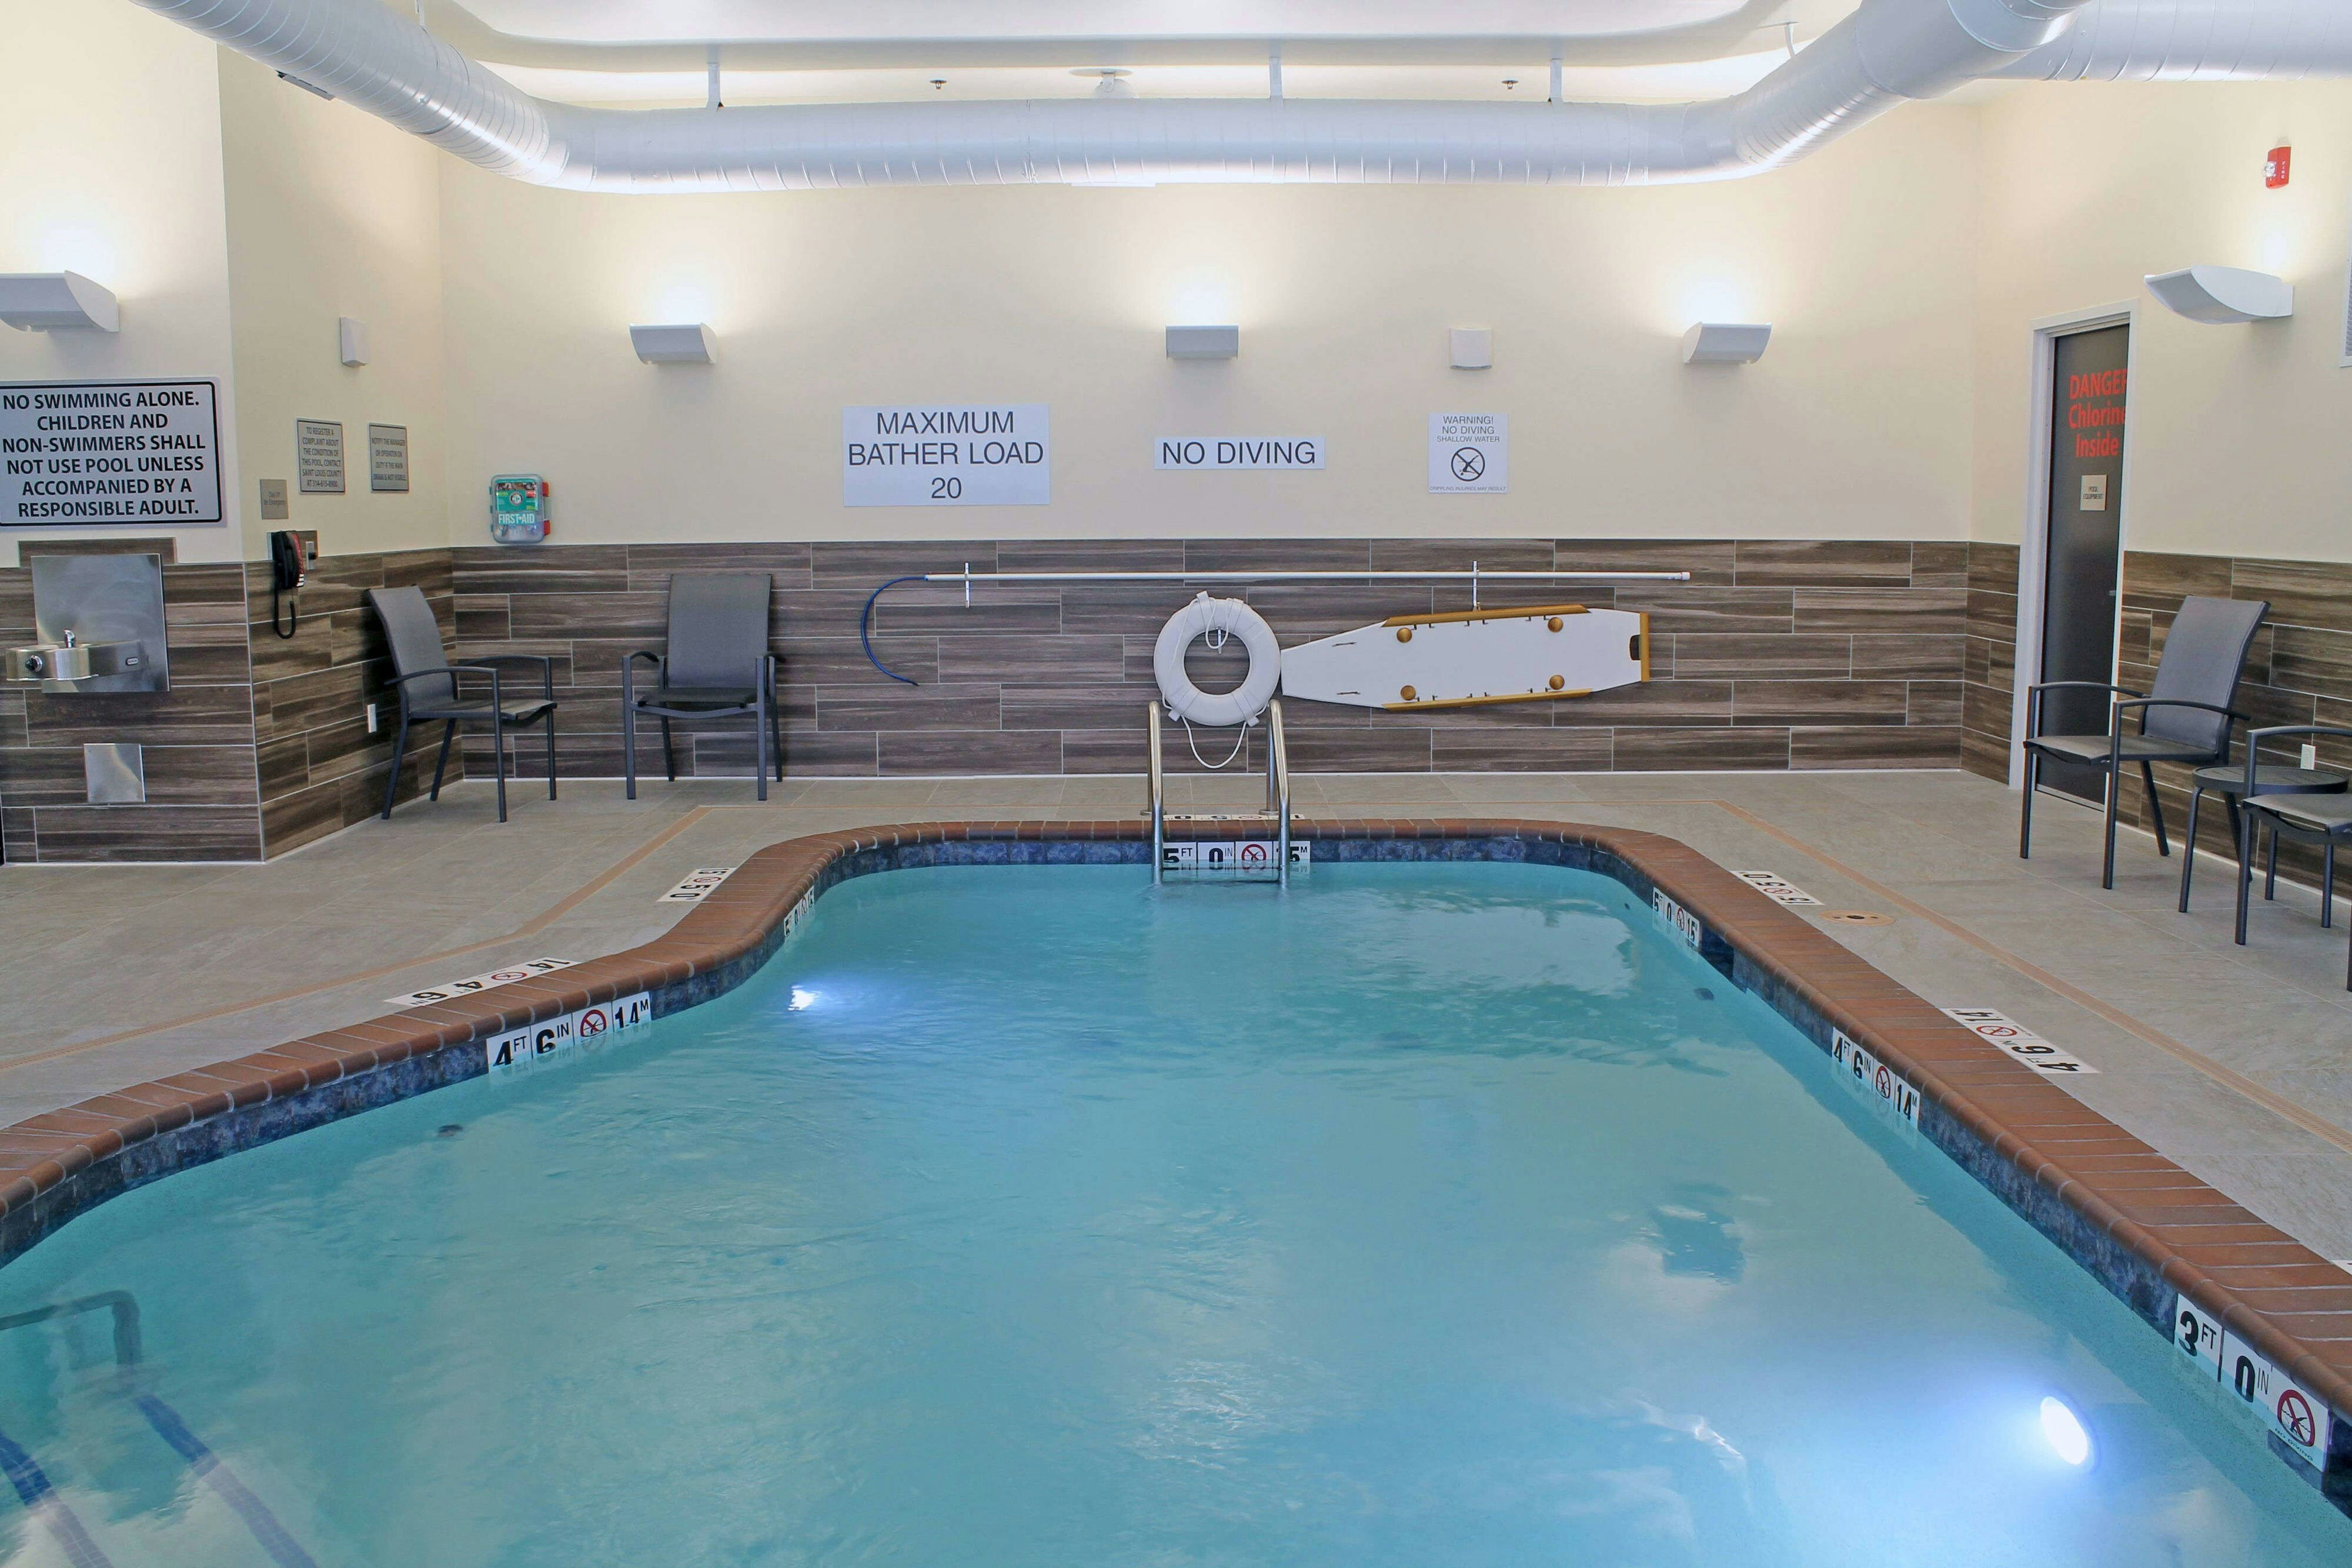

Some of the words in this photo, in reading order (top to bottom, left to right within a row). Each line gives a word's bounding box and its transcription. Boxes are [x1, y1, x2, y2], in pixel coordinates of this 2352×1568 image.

[3, 394, 29, 410] NO
[34, 392, 131, 409] SWIMMING
[136, 391, 199, 407] ALONE.
[37, 414, 125, 431] CHILDREN
[130, 413, 168, 429] AND
[877, 411, 1014, 434] MAXIMUM
[1443, 416, 1494, 424] WARNING!
[1442, 426, 1457, 434] NO
[1461, 426, 1495, 434] DIVING
[3, 436, 146, 453] NON-SWIMMERS
[151, 434, 205, 450] SHALL
[1163, 442, 1205, 464] NO
[1217, 442, 1315, 464] DIVING
[2075, 430, 2120, 458] Inside
[848, 442, 959, 466] BATHER
[970, 442, 1044, 464] LOAD
[7, 460, 44, 474] NOT
[48, 458, 81, 473] USE
[86, 458, 133, 473] POOL
[138, 456, 204, 472] UNLESS
[22, 479, 149, 496] ACCOMPANIED
[154, 478, 175, 493] BY
[181, 478, 192, 492] A
[931, 477, 962, 499] 20
[19, 501, 134, 517] RESPONSIBLE
[139, 499, 199, 515] ADULT.
[498, 514, 519, 524] FIRST
[522, 514, 534, 523] AID
[514, 1035, 527, 1052] FT
[557, 1022, 569, 1038] IN
[2178, 1310, 2199, 1357] 3
[2201, 1322, 2216, 1350] FT
[2234, 1355, 2256, 1403] 0
[2258, 1368, 2269, 1395] IN
